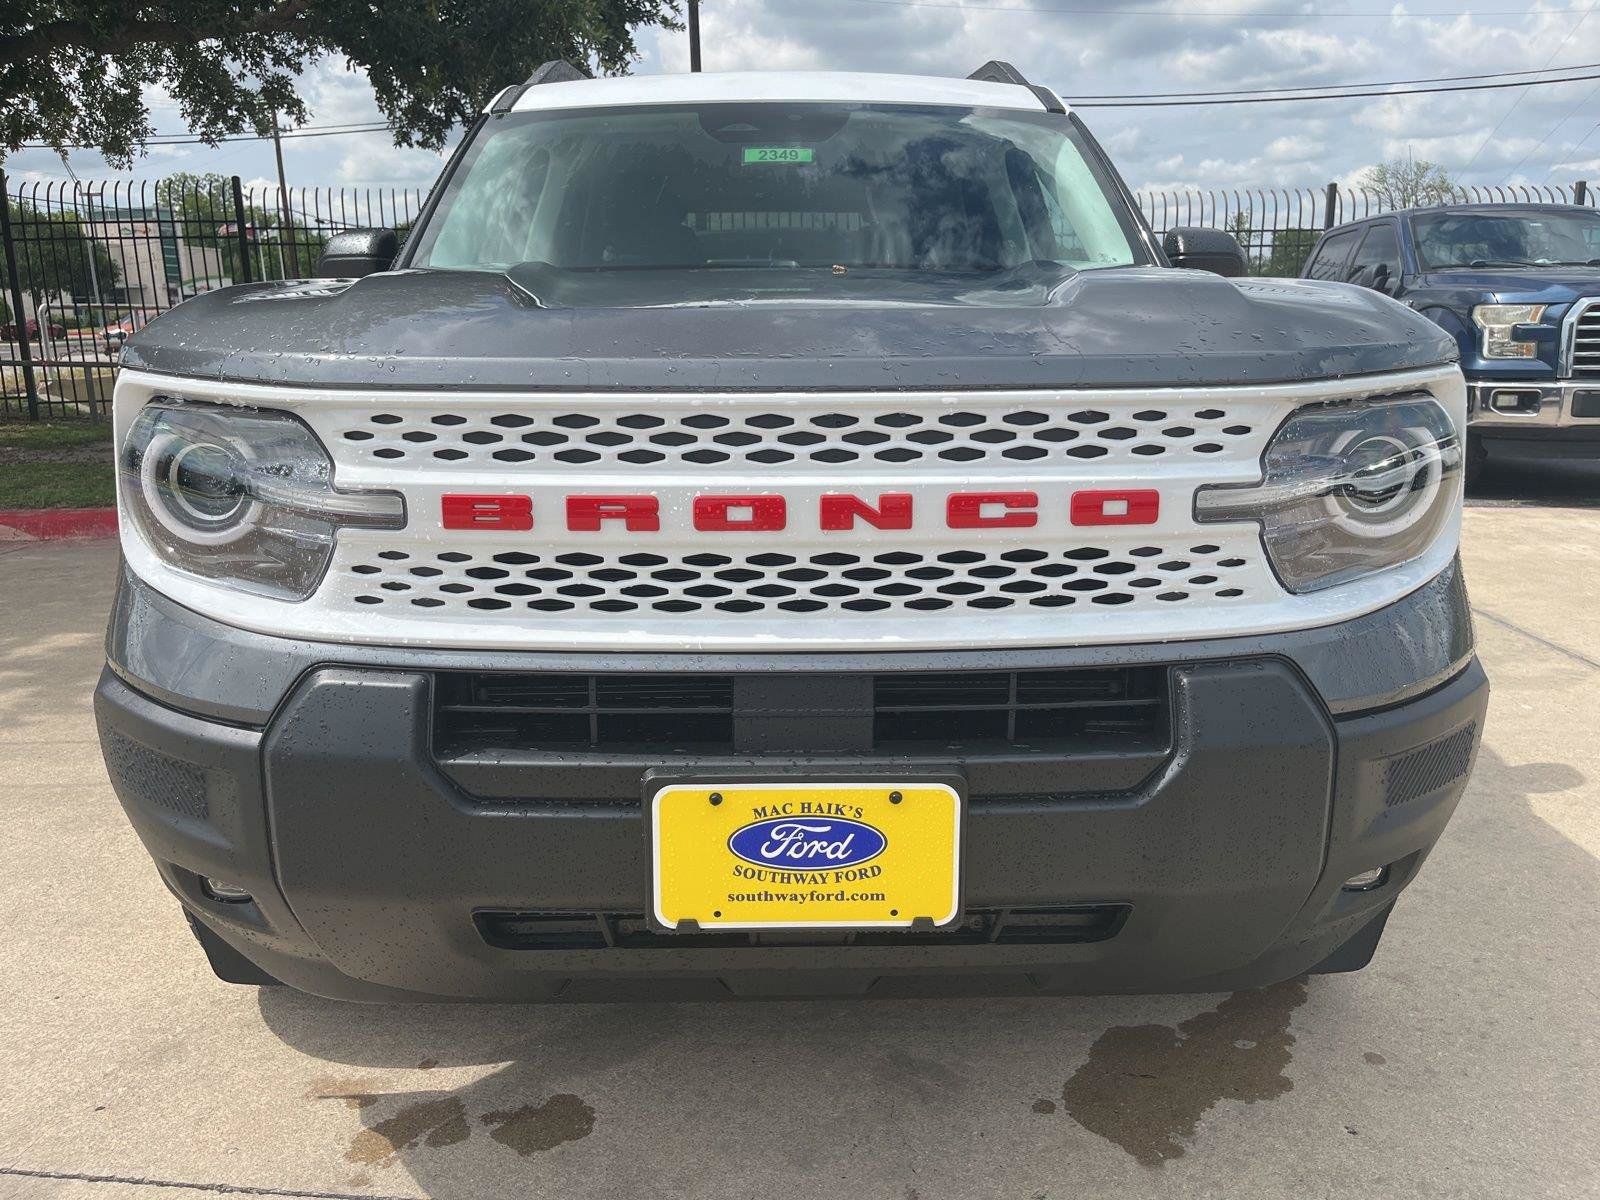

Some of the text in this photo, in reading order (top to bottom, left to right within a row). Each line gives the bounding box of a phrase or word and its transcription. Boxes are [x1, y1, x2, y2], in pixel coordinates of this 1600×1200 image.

[758, 149, 798, 160] 2349
[441, 489, 1160, 531] BRONCO
[753, 802, 863, 819] MAC HAIK'S
[761, 823, 854, 859] Ford
[733, 865, 882, 884] SOUTHWAY FORD
[727, 890, 886, 904] southwayford.com
